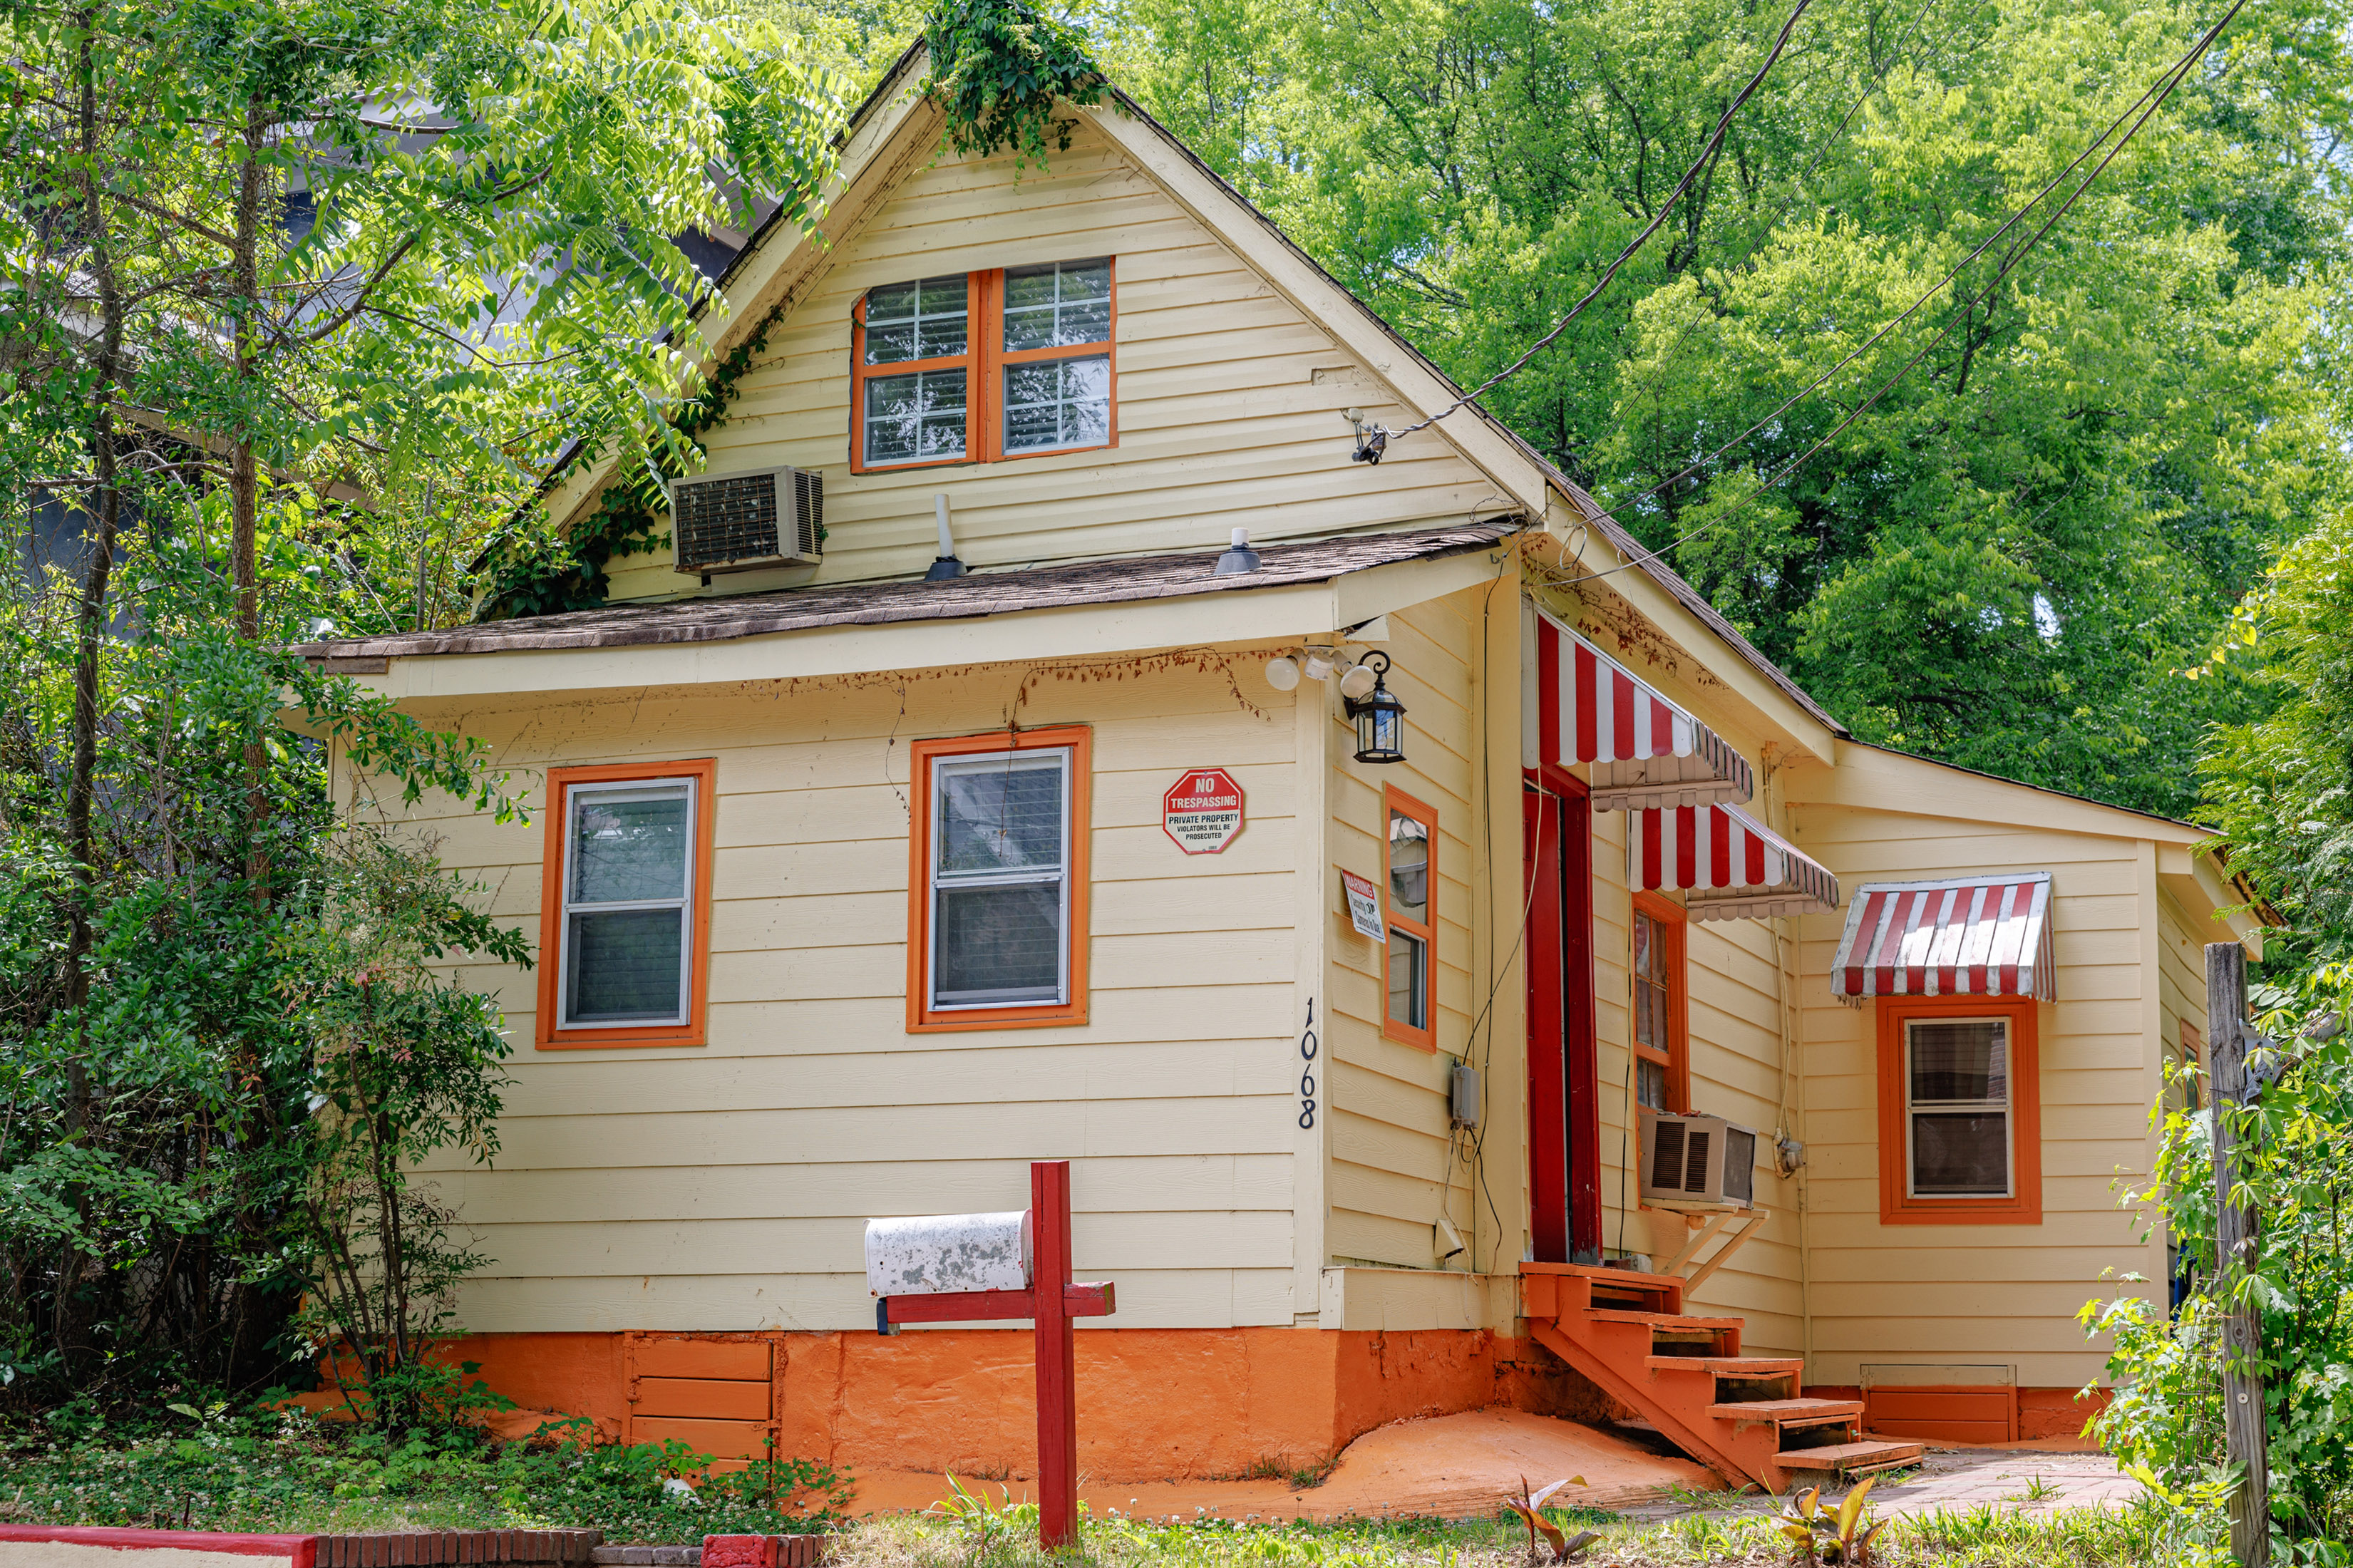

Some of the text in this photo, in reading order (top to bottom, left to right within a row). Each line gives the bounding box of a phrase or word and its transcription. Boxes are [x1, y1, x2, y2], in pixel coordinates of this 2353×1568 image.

[1195, 778, 1215, 793] NO
[1170, 795, 1237, 809] TRESPASSING
[1169, 813, 1239, 825] PRIVATE PROPERTY
[1344, 872, 1373, 898] WARNING
[1299, 997, 1317, 1130] 1068
